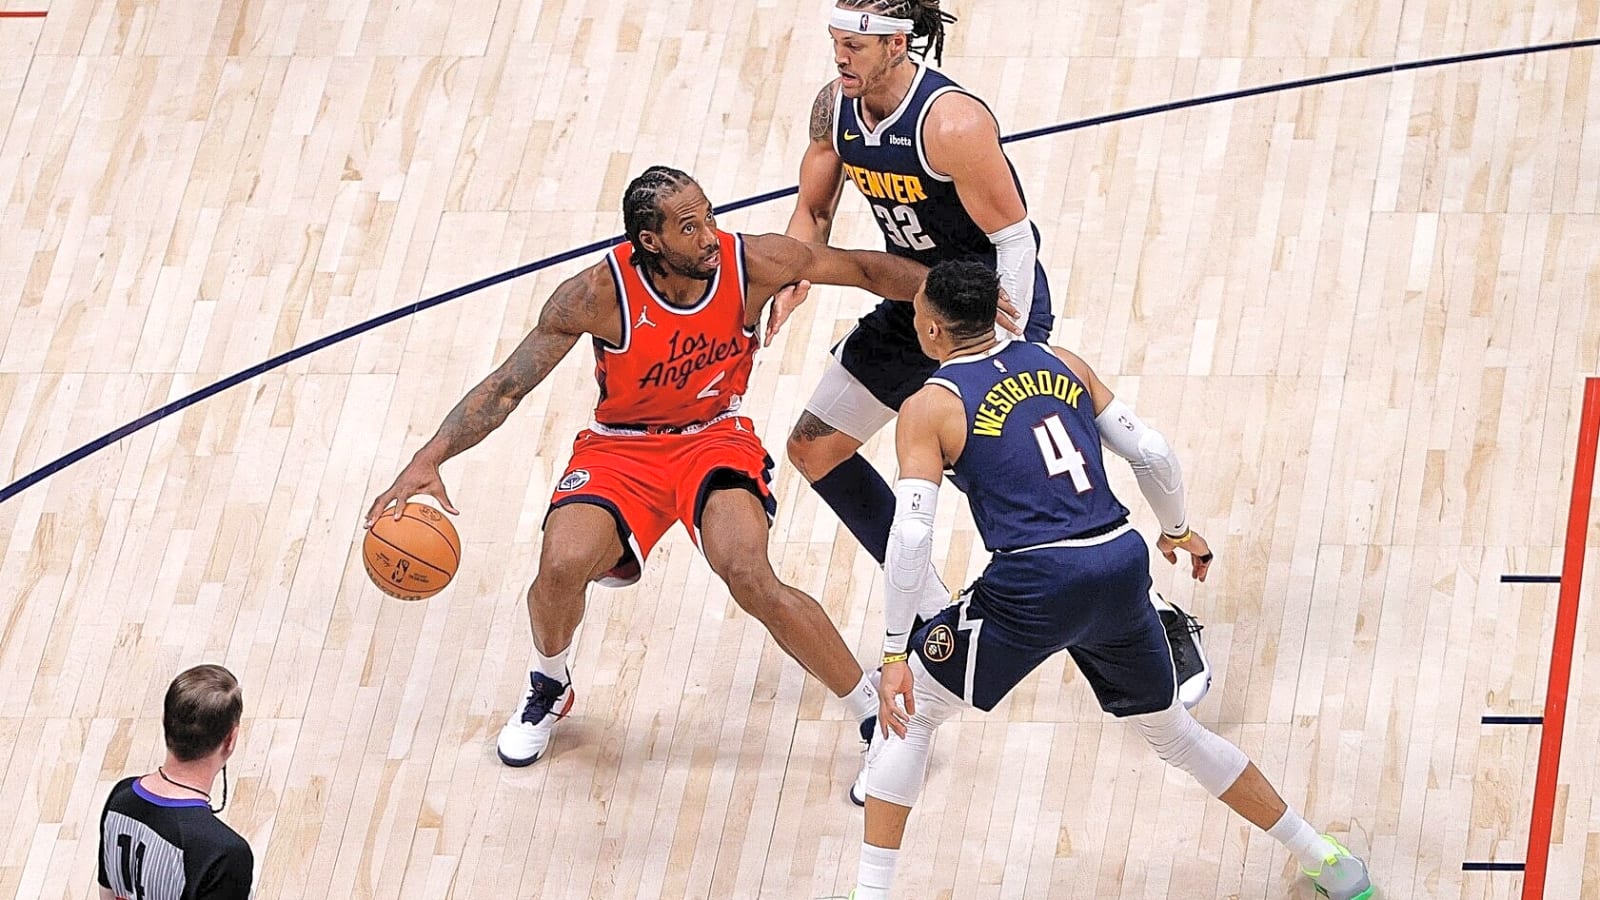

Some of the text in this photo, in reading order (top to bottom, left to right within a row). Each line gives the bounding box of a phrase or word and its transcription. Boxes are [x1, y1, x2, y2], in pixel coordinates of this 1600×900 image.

[889, 134, 912, 147] ibotta
[873, 204, 936, 251] 32
[639, 336, 743, 390] Angeles
[668, 330, 709, 363] Los
[972, 369, 1084, 437] WESTBROOK
[1032, 412, 1093, 496] 4
